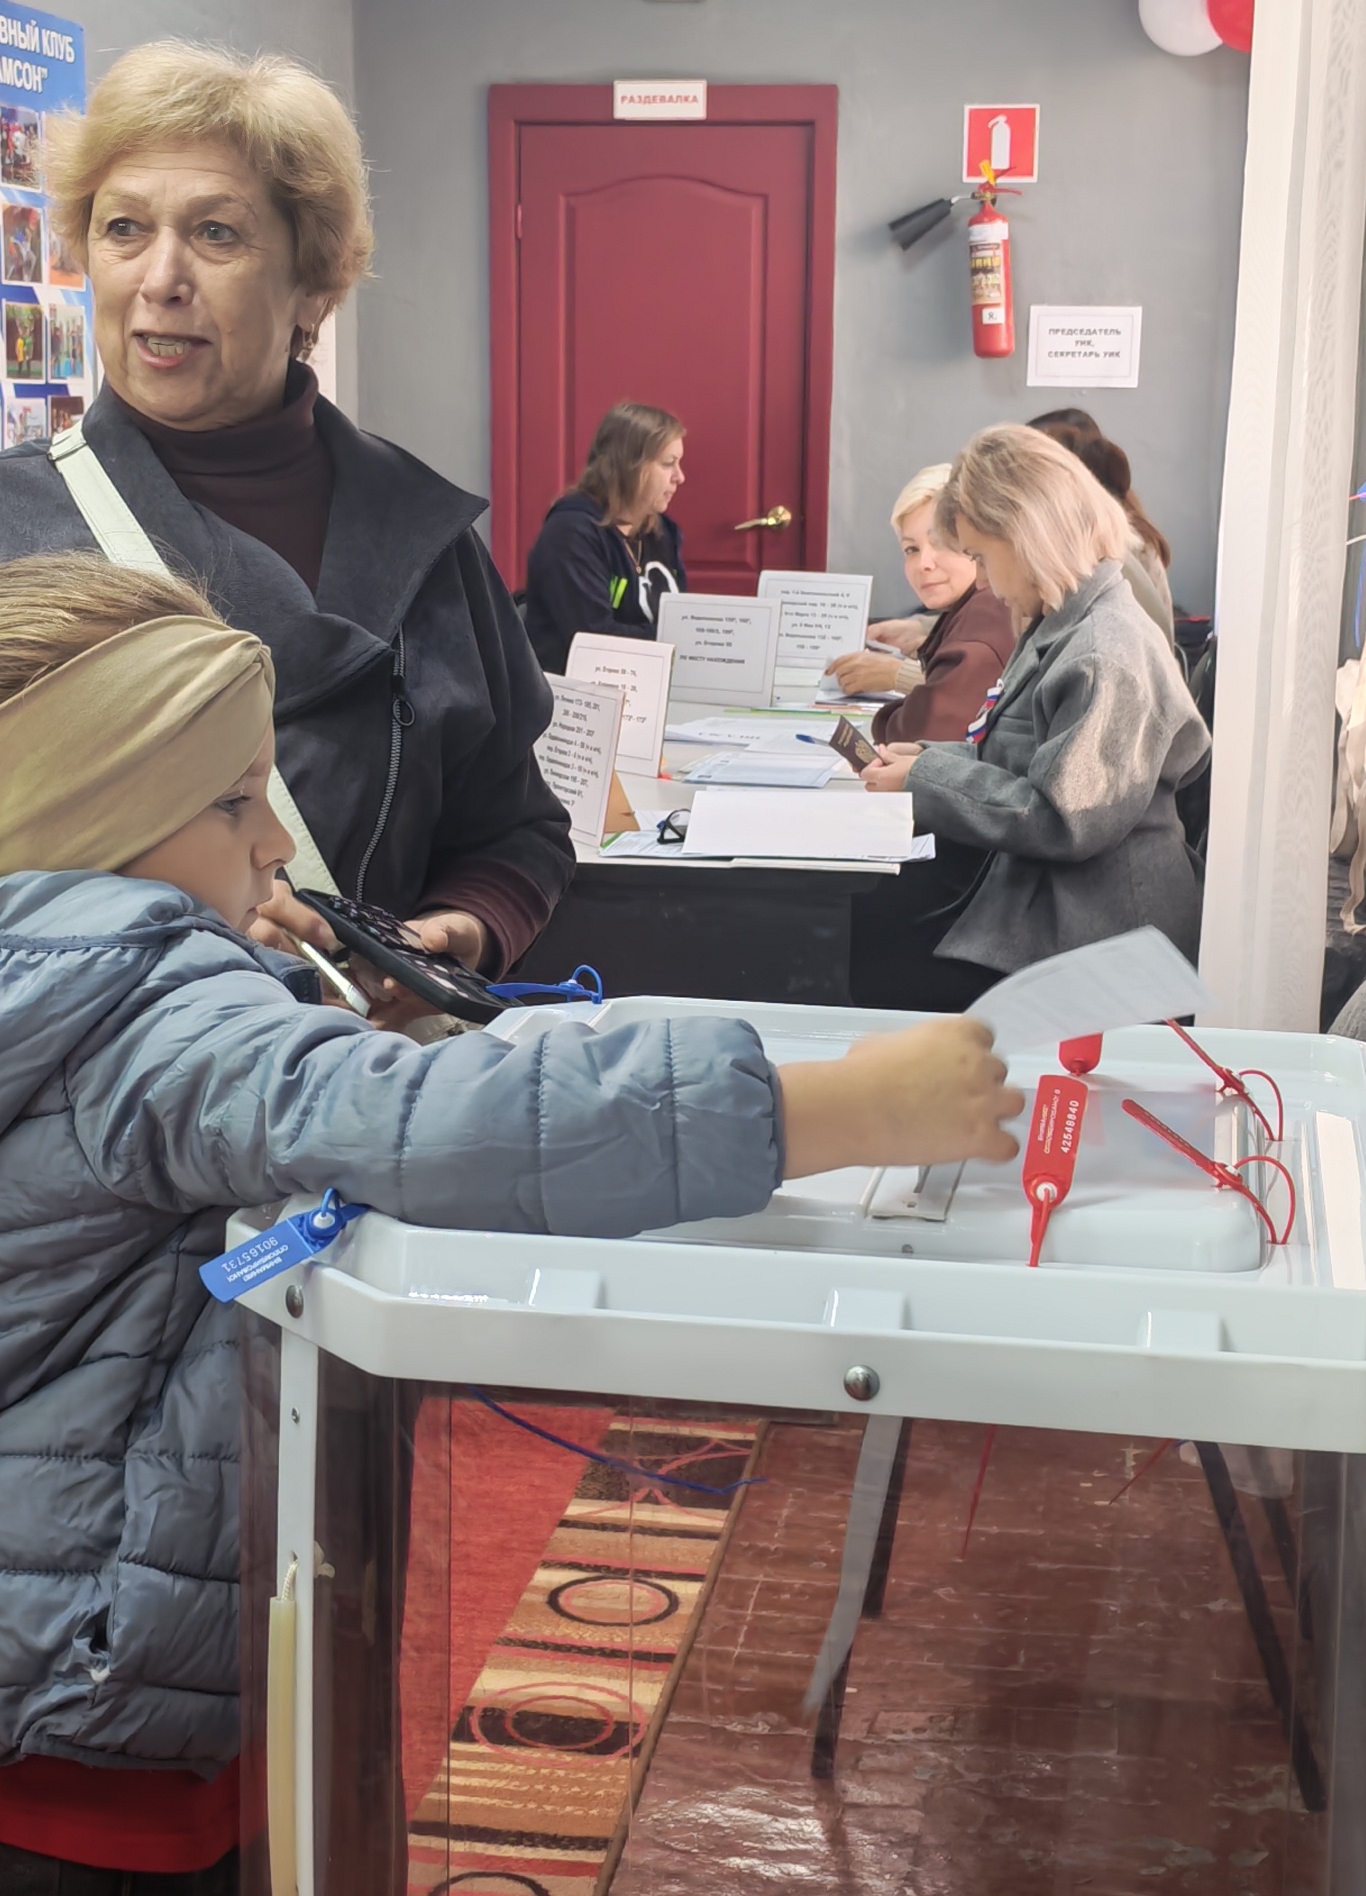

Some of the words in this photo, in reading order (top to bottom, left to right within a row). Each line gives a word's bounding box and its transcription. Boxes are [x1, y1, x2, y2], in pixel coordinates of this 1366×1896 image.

[42, 28, 75, 64] КЛУБ
[620, 94, 698, 105] РАЗДЕВАЛКА
[1048, 328, 1122, 336] ПРЕДСЕДАТЕЛЬ
[1074, 339, 1095, 347] УИК,
[221, 1236, 279, 1273] 90165731
